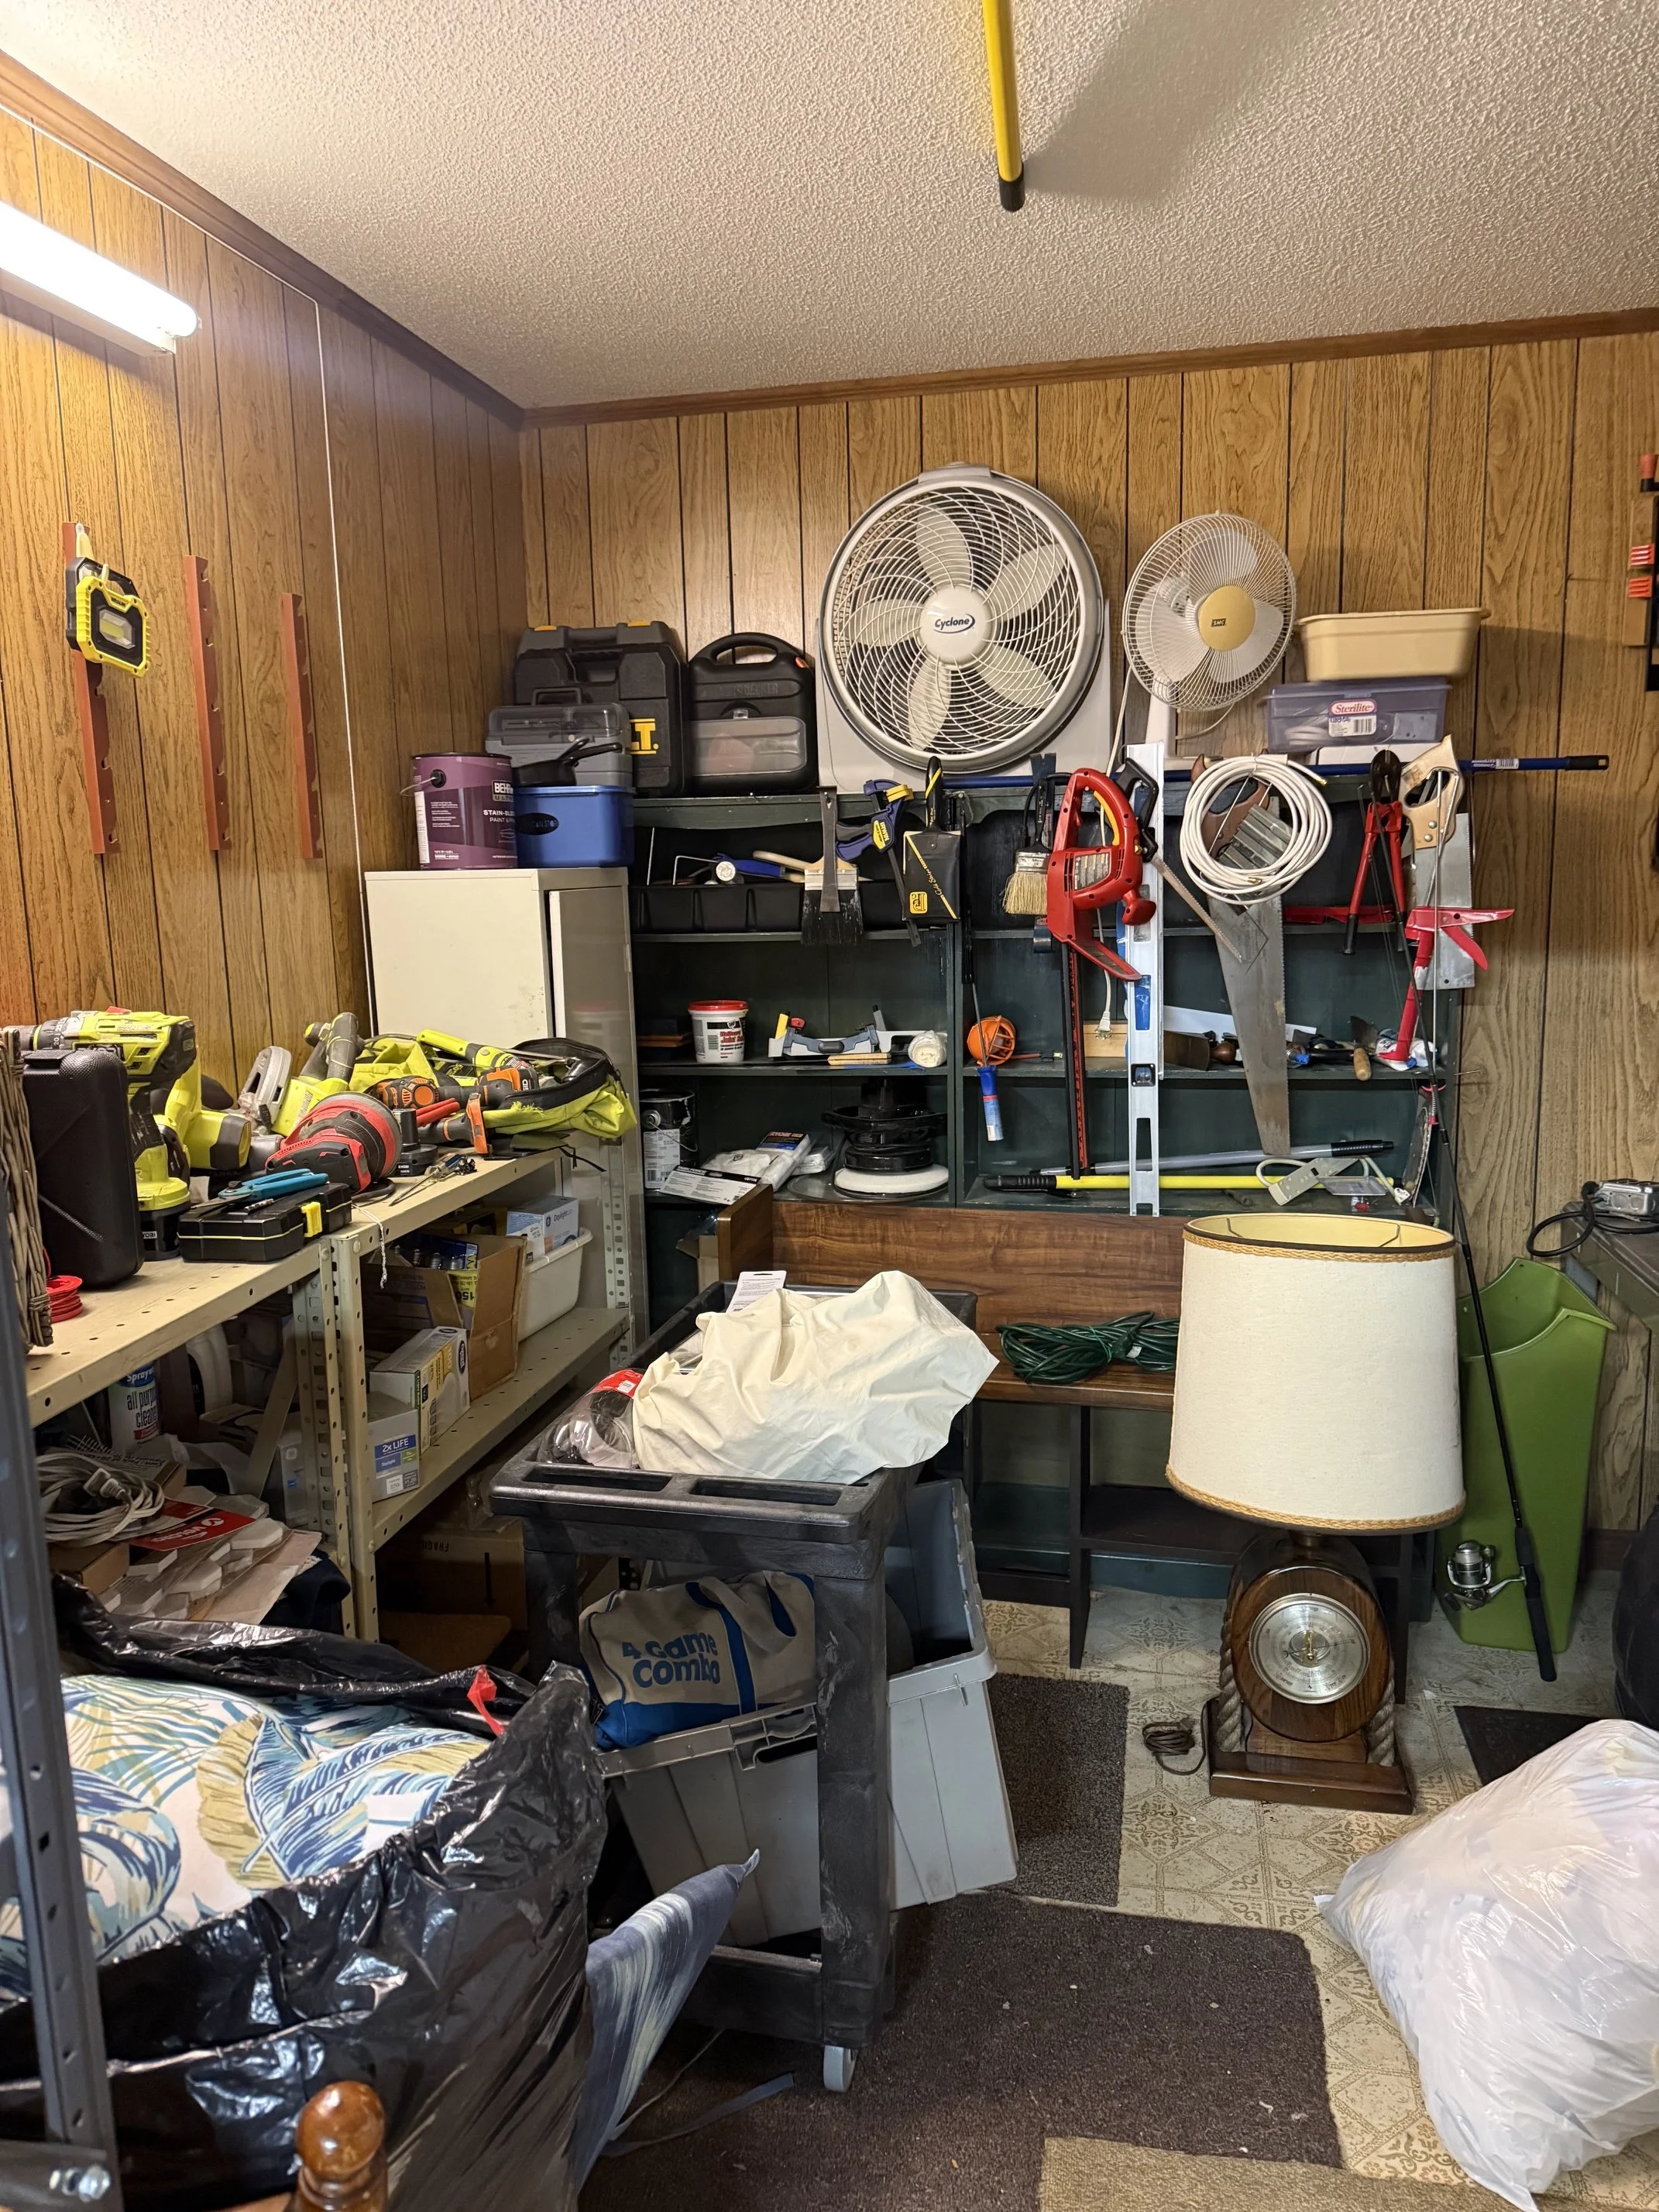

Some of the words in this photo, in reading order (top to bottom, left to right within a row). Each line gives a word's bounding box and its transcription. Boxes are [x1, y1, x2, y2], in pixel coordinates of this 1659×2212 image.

[935, 617, 970, 630] Cyclone
[1335, 702, 1370, 713] Sterilite
[879, 821, 890, 842] IRWIN
[553, 1211, 568, 1223] Daylight
[126, 1391, 138, 1410] all
[382, 1444, 393, 1453] 2x
[393, 1437, 409, 1451] LIFE
[621, 1641, 642, 1661] 4
